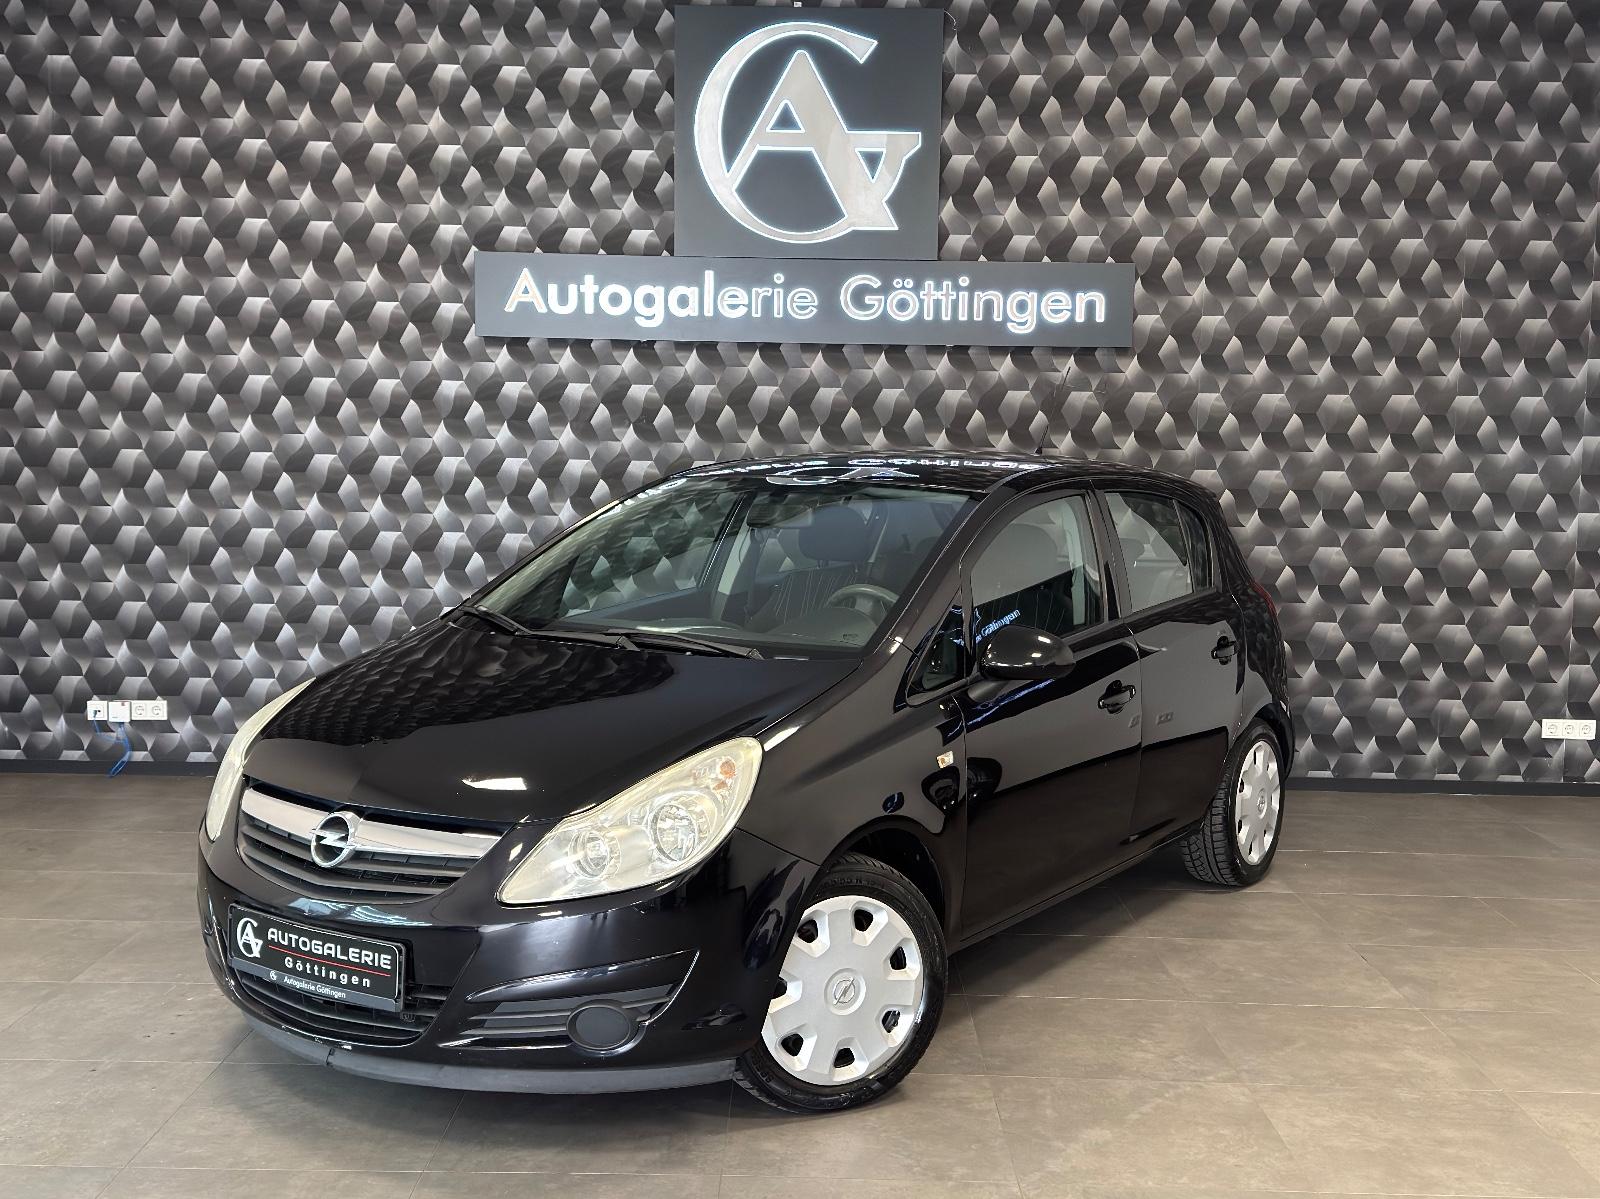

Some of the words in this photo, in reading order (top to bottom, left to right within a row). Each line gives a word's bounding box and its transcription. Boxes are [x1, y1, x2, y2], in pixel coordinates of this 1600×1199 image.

[504, 267, 818, 328] Autogalerie
[840, 274, 1105, 334] Göttingen
[267, 927, 392, 970] AUTOGALERIE
[283, 976, 315, 991] Autogalerie
[316, 985, 346, 998] Göttingen
[284, 956, 371, 988] Göttingen
